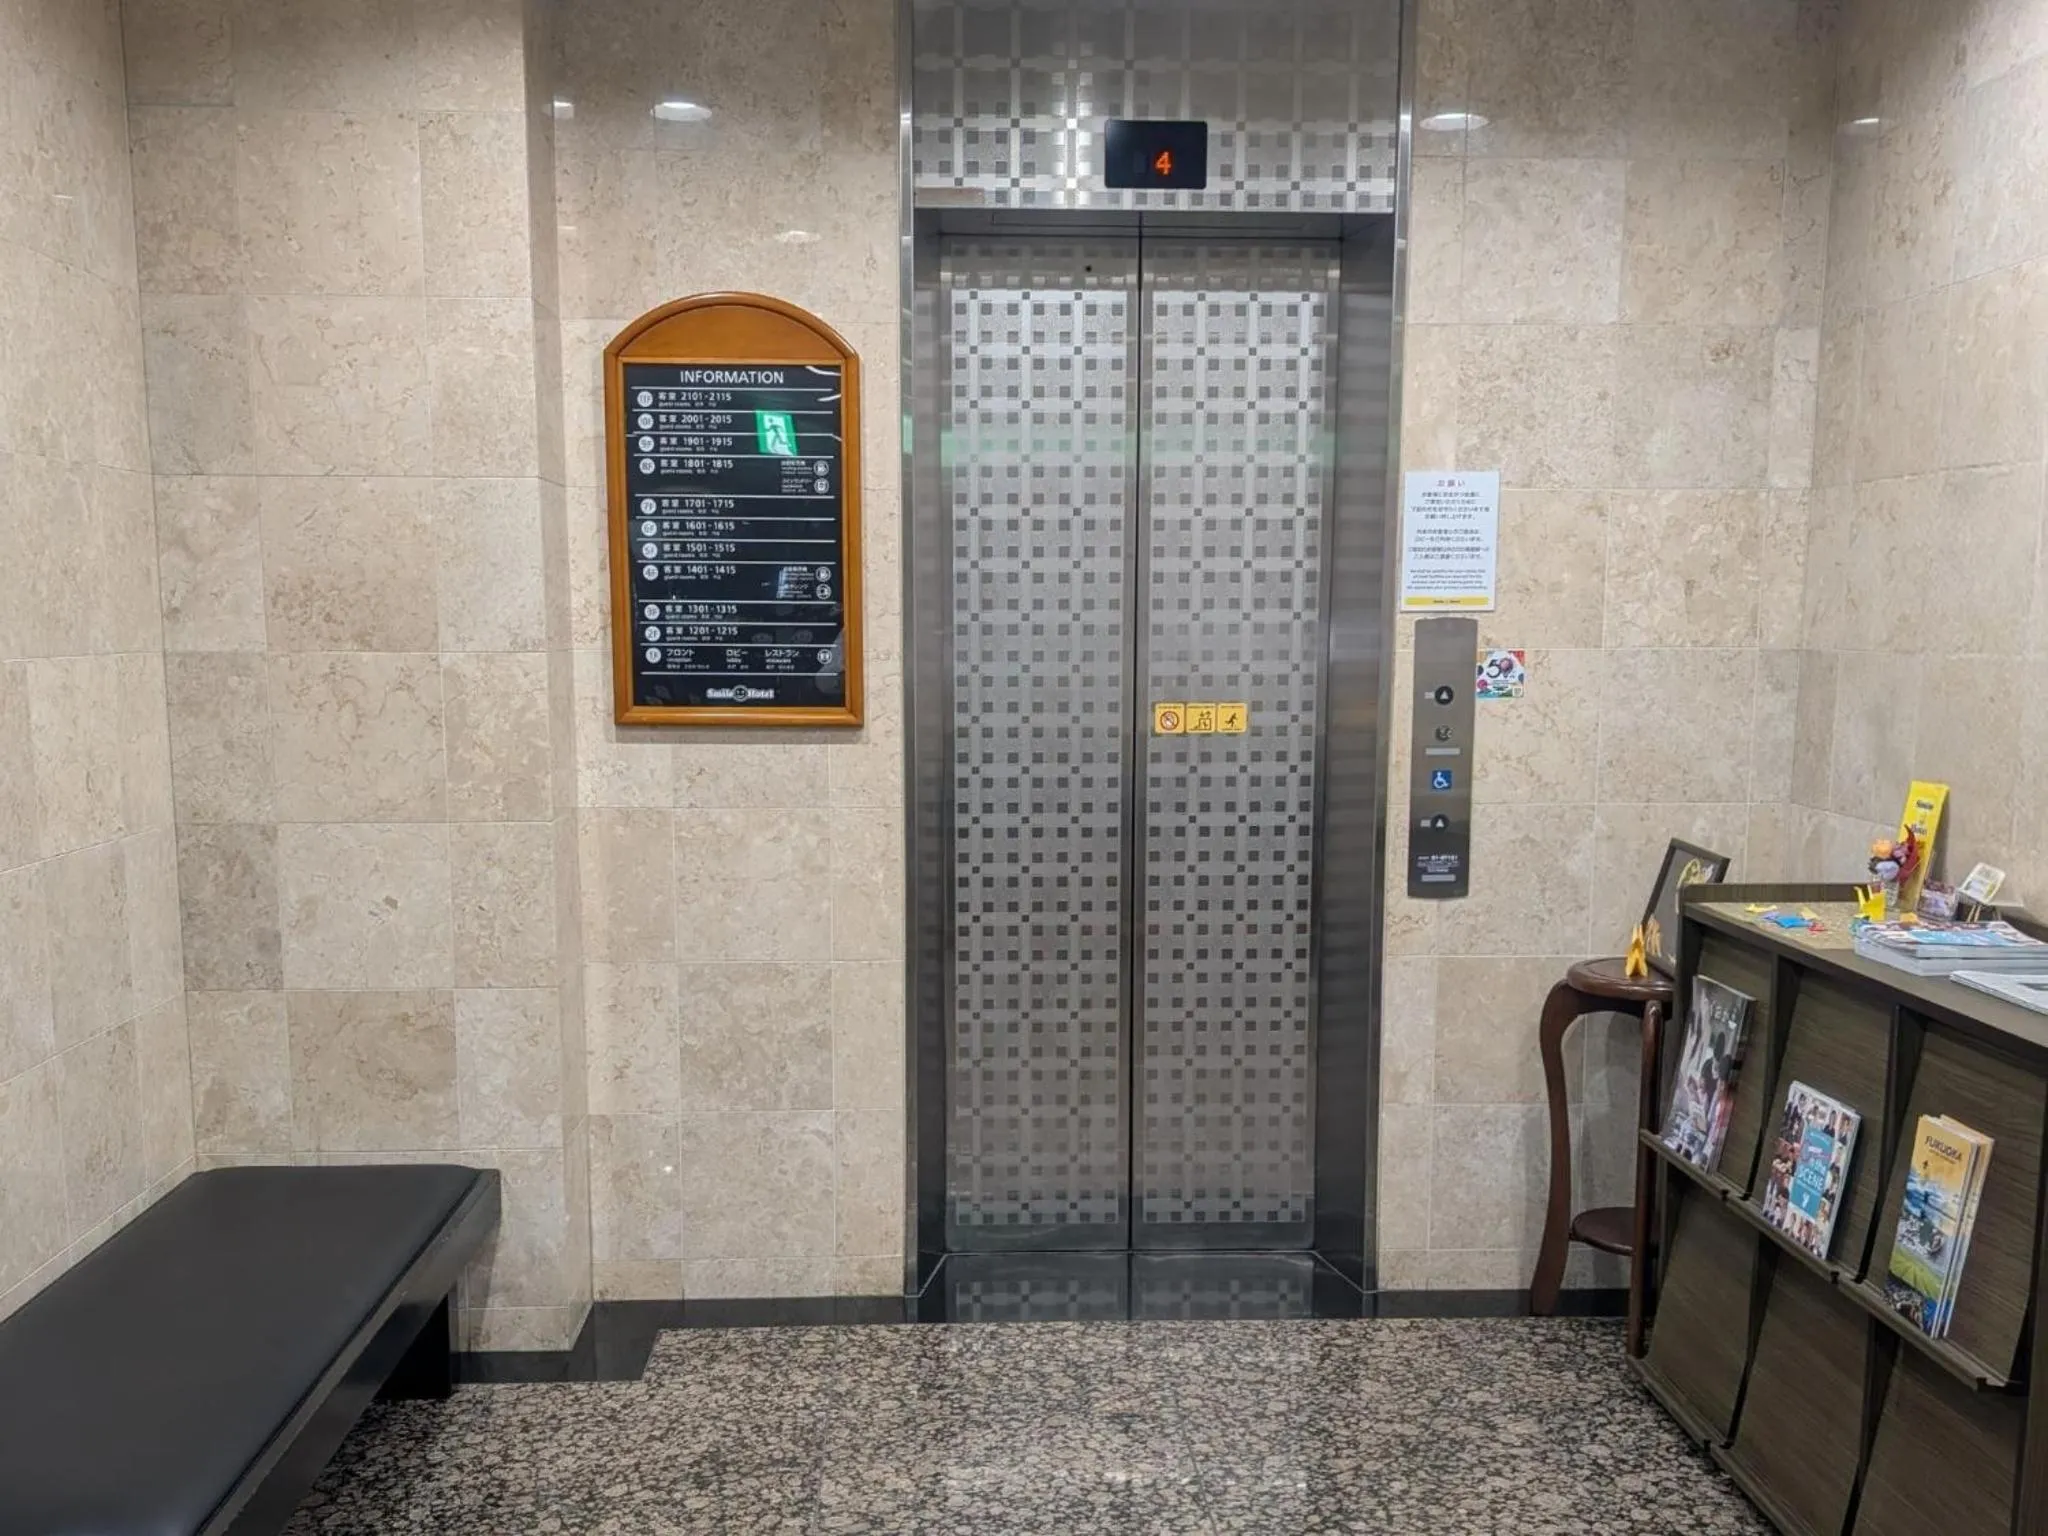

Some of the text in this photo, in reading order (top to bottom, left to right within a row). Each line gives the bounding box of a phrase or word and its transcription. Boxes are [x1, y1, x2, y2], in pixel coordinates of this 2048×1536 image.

[1154, 151, 1172, 176] 4
[680, 371, 784, 384] INFORMATION
[666, 649, 695, 657] フロント
[726, 649, 748, 657] ロビー
[765, 649, 800, 657] レストラン
